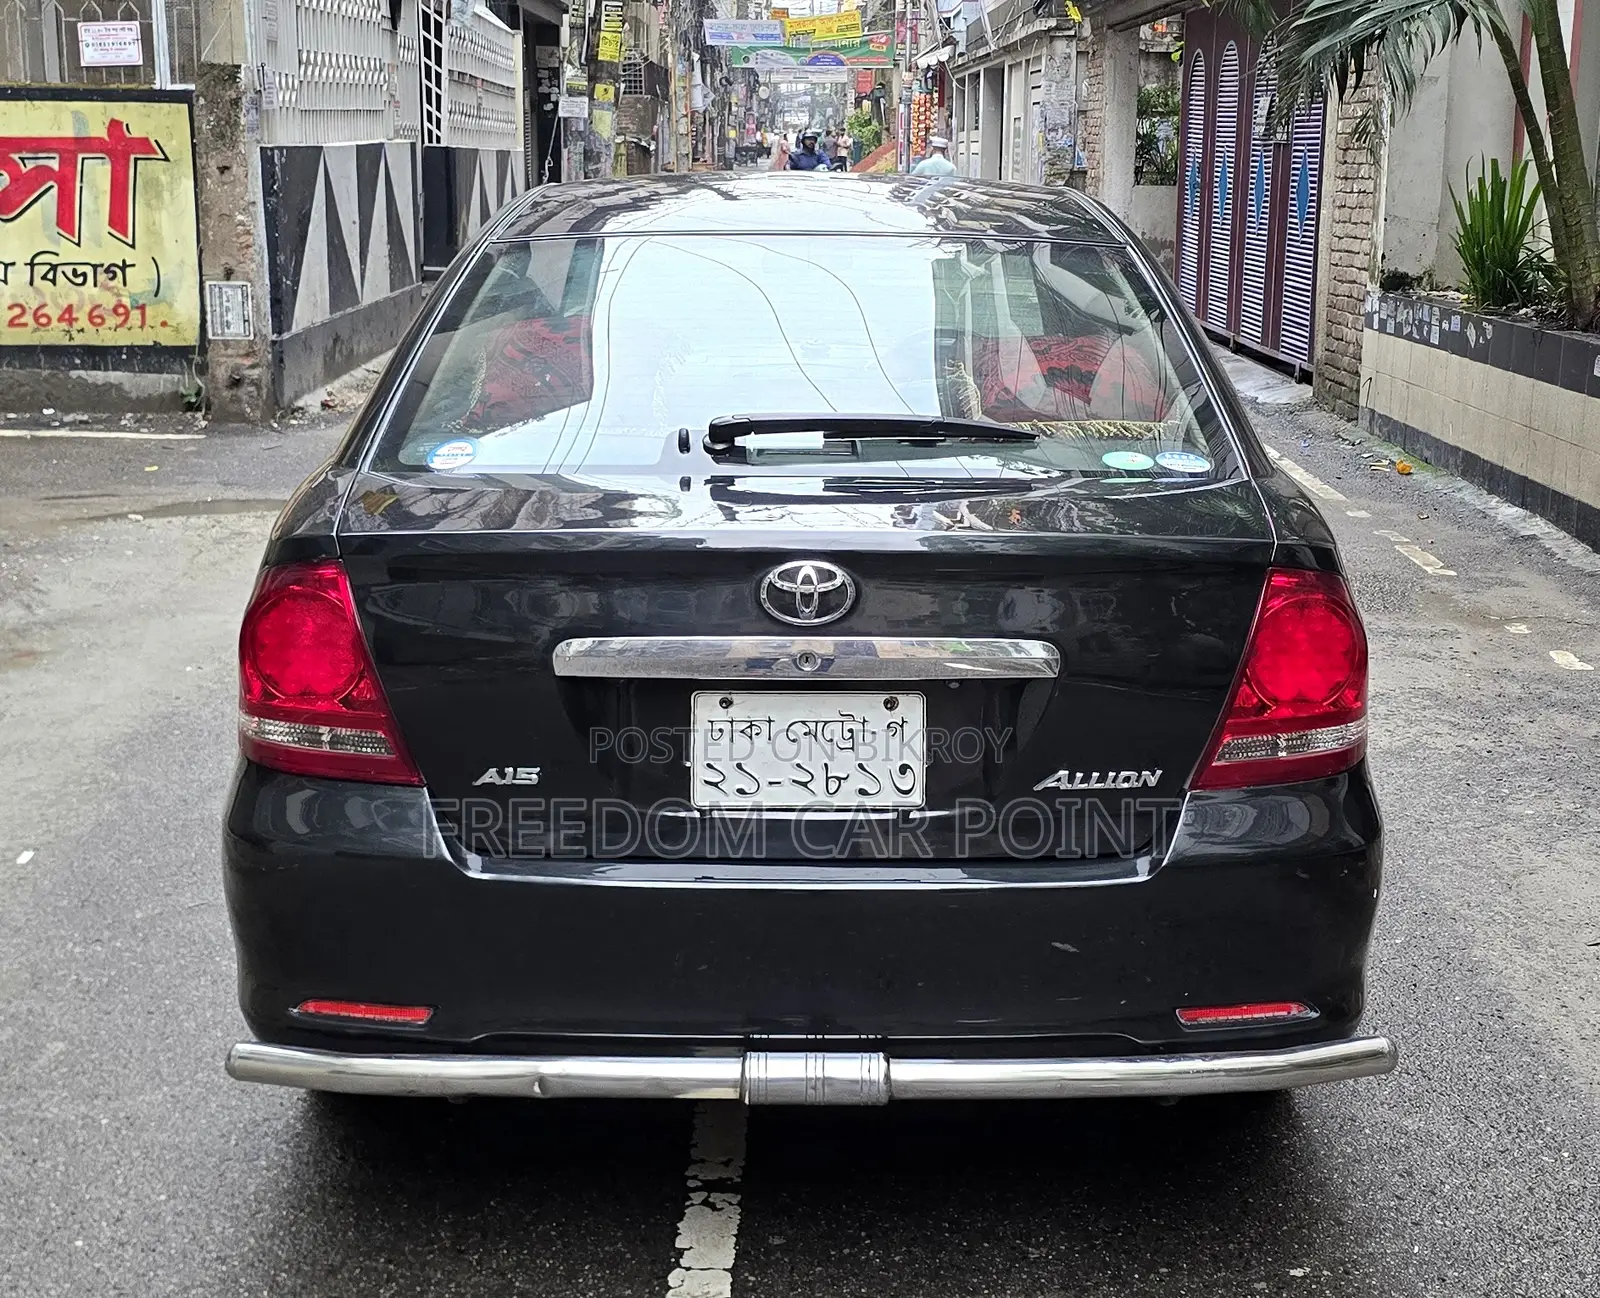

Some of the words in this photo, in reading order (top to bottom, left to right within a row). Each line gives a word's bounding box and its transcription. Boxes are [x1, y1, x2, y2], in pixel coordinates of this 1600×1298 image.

[24, 250, 136, 287] বিভাগ
[707, 716, 775, 743] ঢাকা
[472, 766, 541, 786] A15
[702, 762, 917, 797] ২১-২৮১৩
[1033, 768, 1163, 791] ALLION
